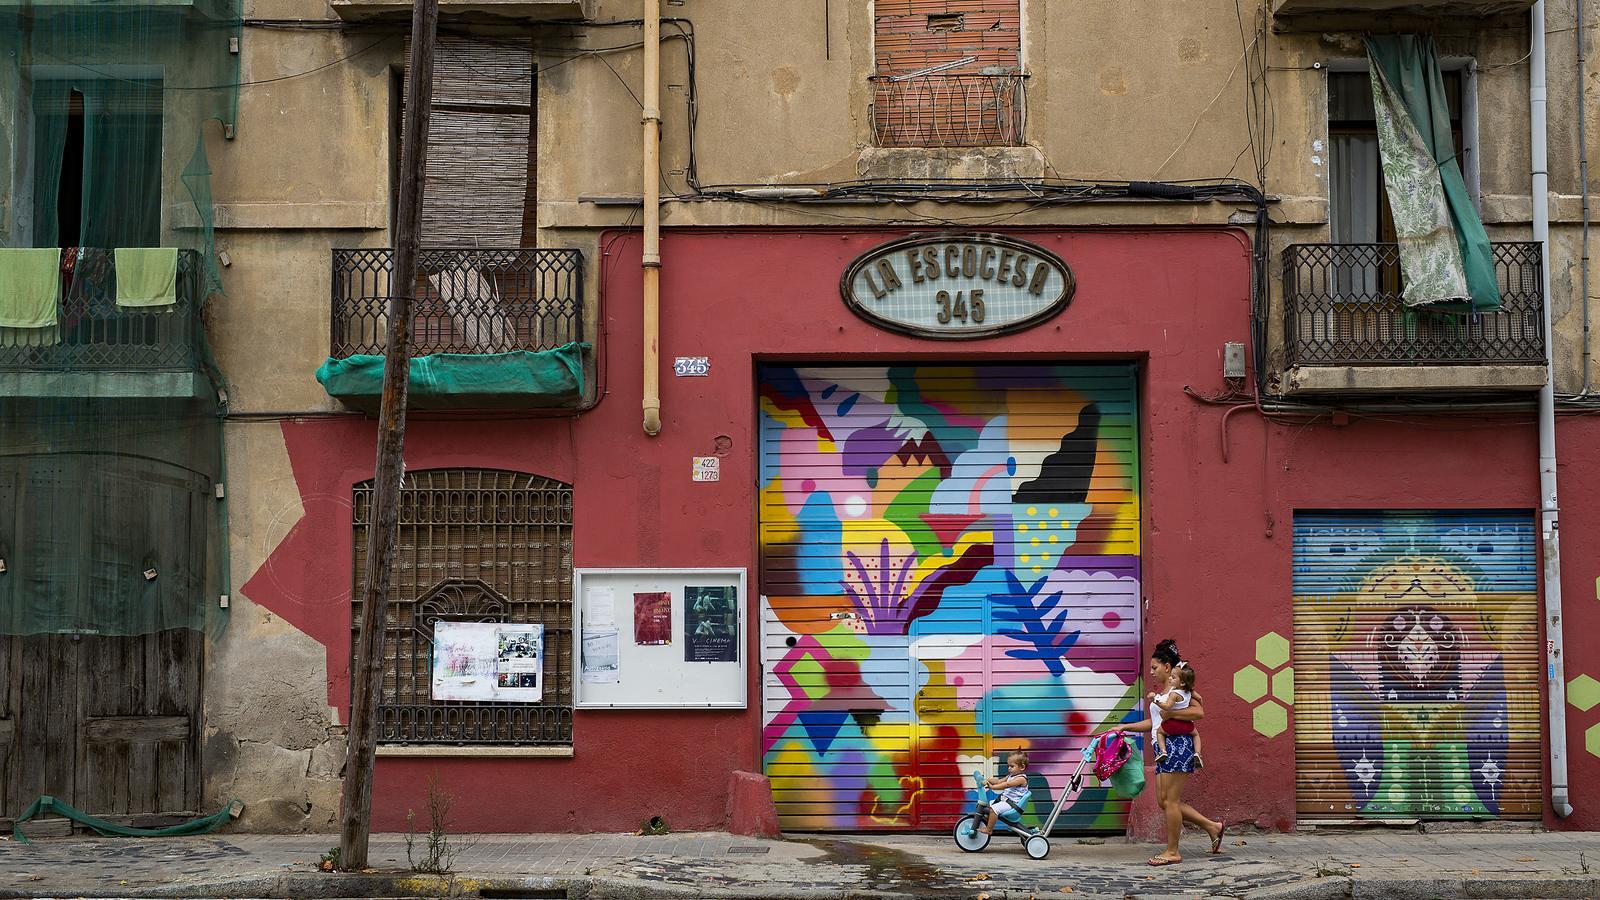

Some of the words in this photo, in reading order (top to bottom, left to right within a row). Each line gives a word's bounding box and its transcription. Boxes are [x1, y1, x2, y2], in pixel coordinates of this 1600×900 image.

[863, 258, 902, 299] LA
[907, 245, 1050, 296] ESCOCESA
[936, 289, 986, 324] 345
[676, 359, 707, 374] 345
[701, 458, 715, 467] 422
[701, 471, 718, 480] 1273
